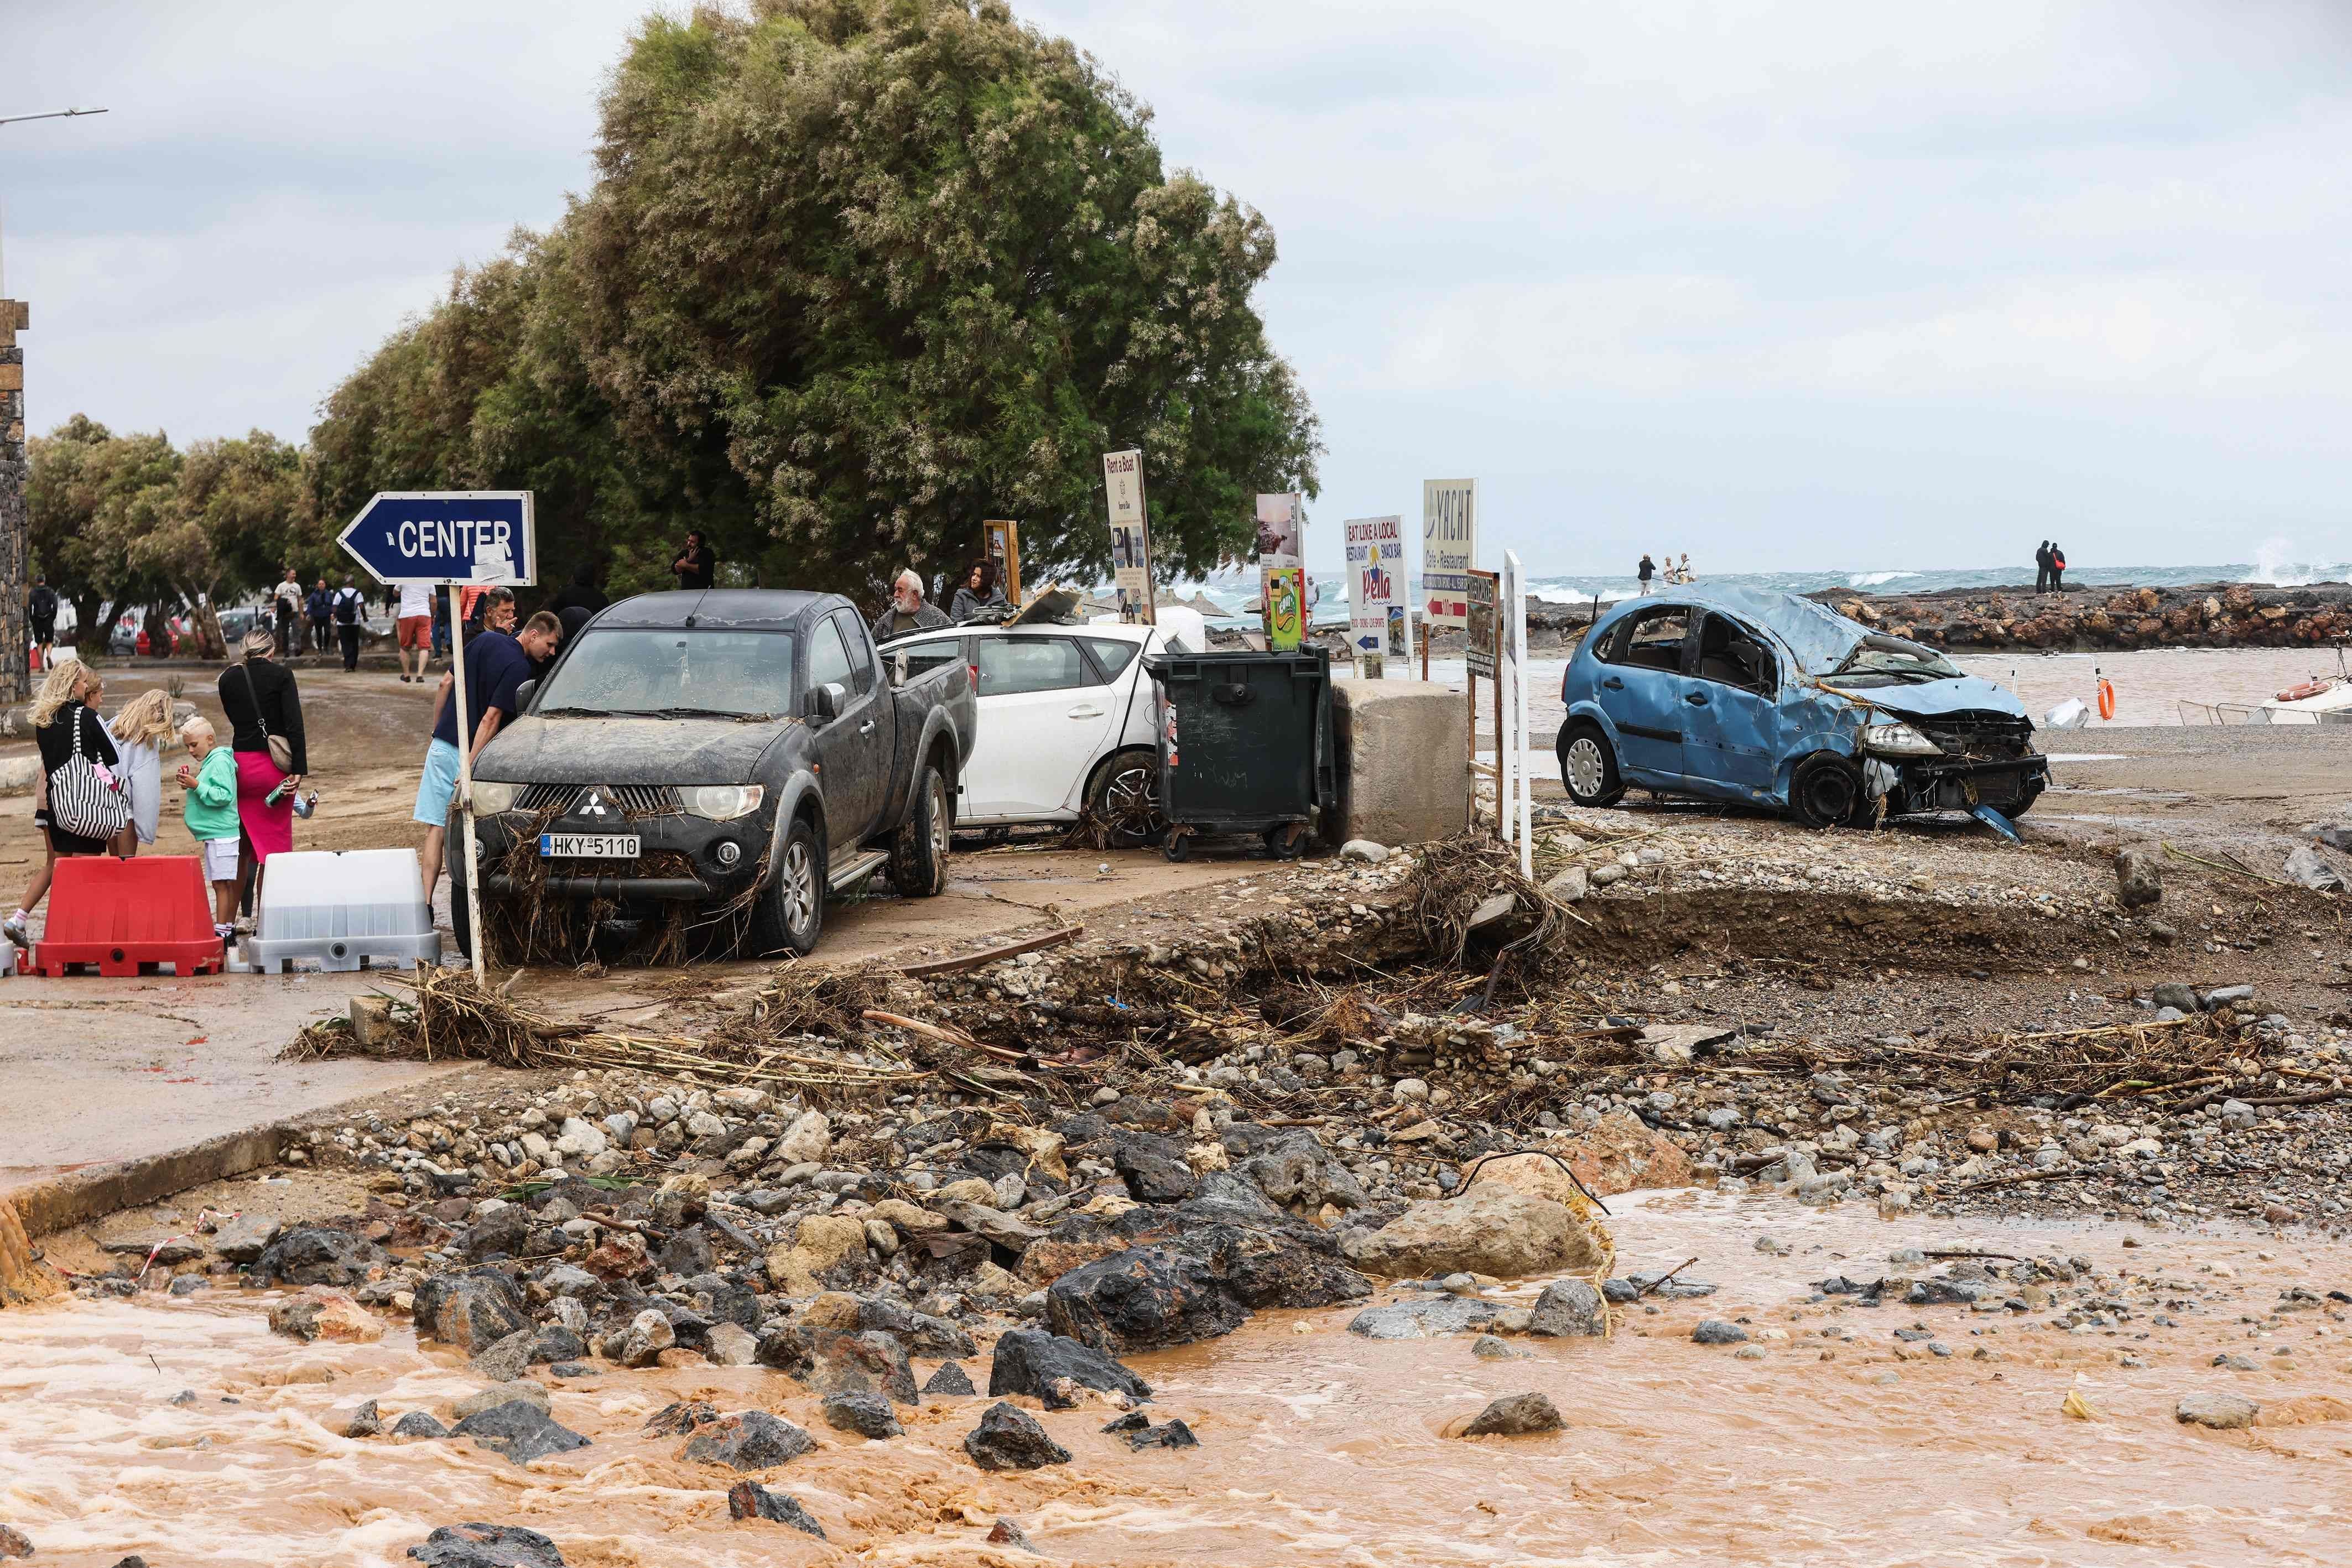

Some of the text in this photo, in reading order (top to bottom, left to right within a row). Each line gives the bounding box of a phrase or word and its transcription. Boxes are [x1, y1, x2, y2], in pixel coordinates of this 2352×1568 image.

[1106, 455, 1134, 474] Rent a Boat
[1437, 489, 1471, 541] YACHT
[399, 520, 512, 558] CENTER
[1348, 522, 1397, 541] EAT LIKE A LOCAL
[1346, 545, 1368, 562] RESTAURANT
[1381, 544, 1394, 559] SNACK
[1440, 550, 1469, 570] Restaurant
